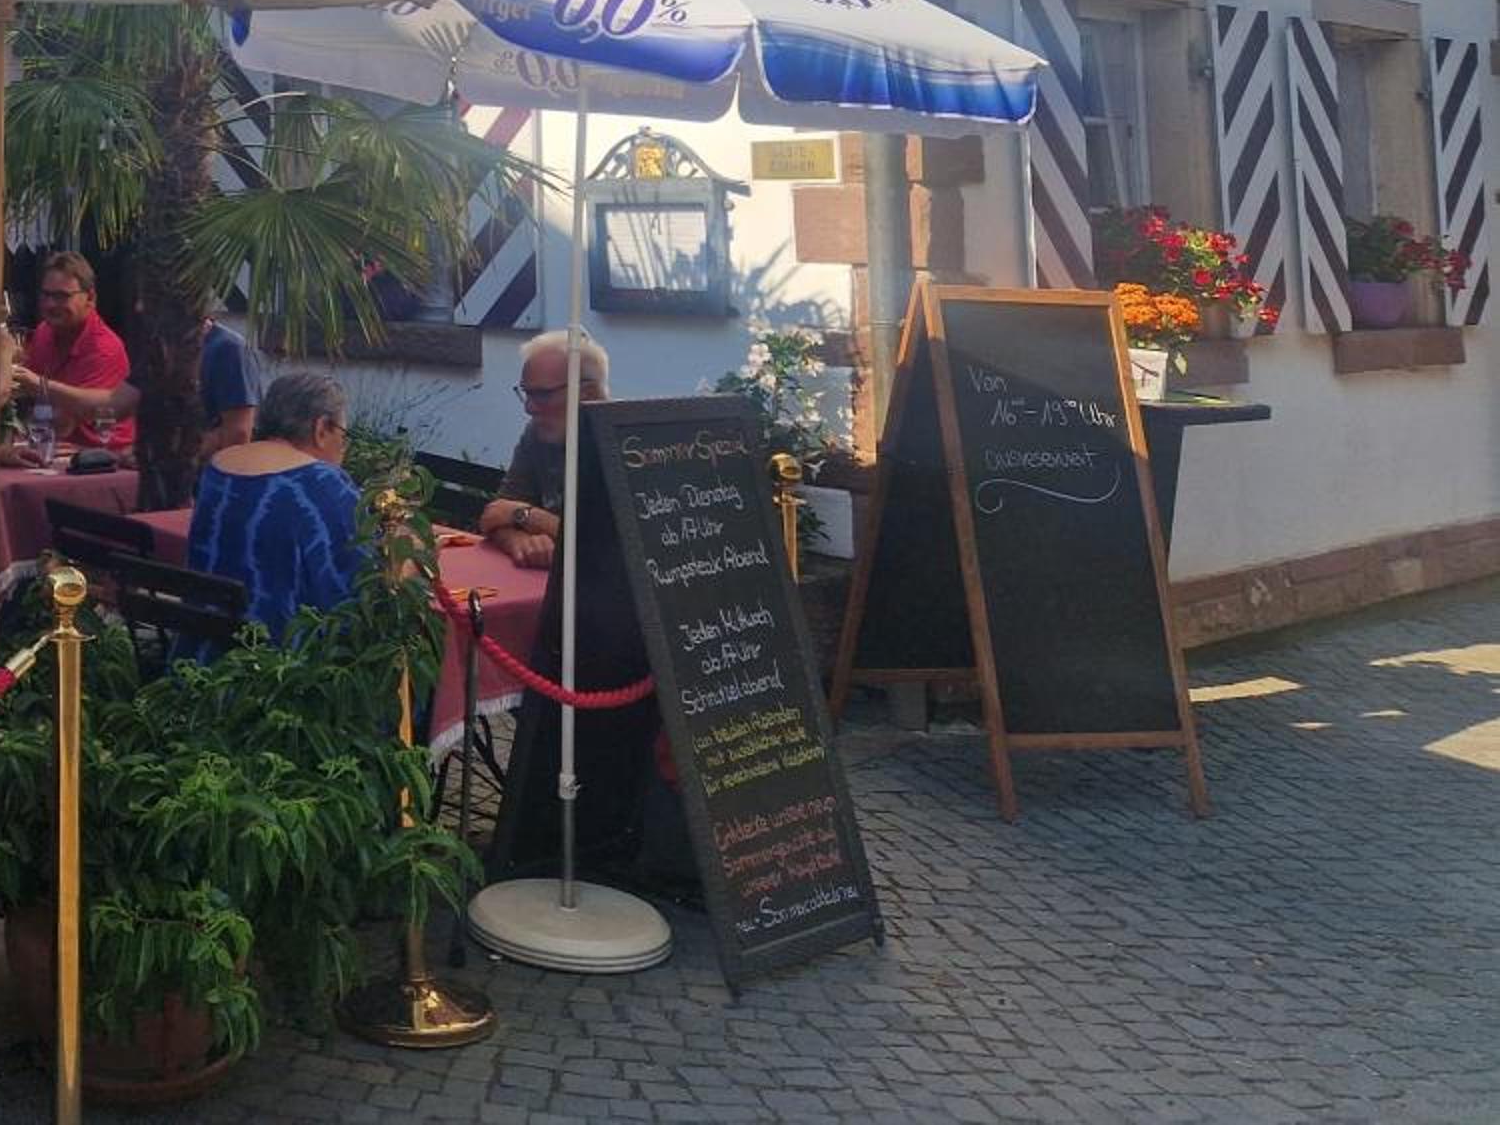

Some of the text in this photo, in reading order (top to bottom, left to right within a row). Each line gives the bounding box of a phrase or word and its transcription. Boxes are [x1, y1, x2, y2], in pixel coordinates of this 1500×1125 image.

[1078, 398, 1116, 428] Uhr
[635, 487, 682, 520] Jeden
[661, 523, 680, 547] ab
[680, 619, 721, 652] Jeden
[701, 652, 721, 675] ab
